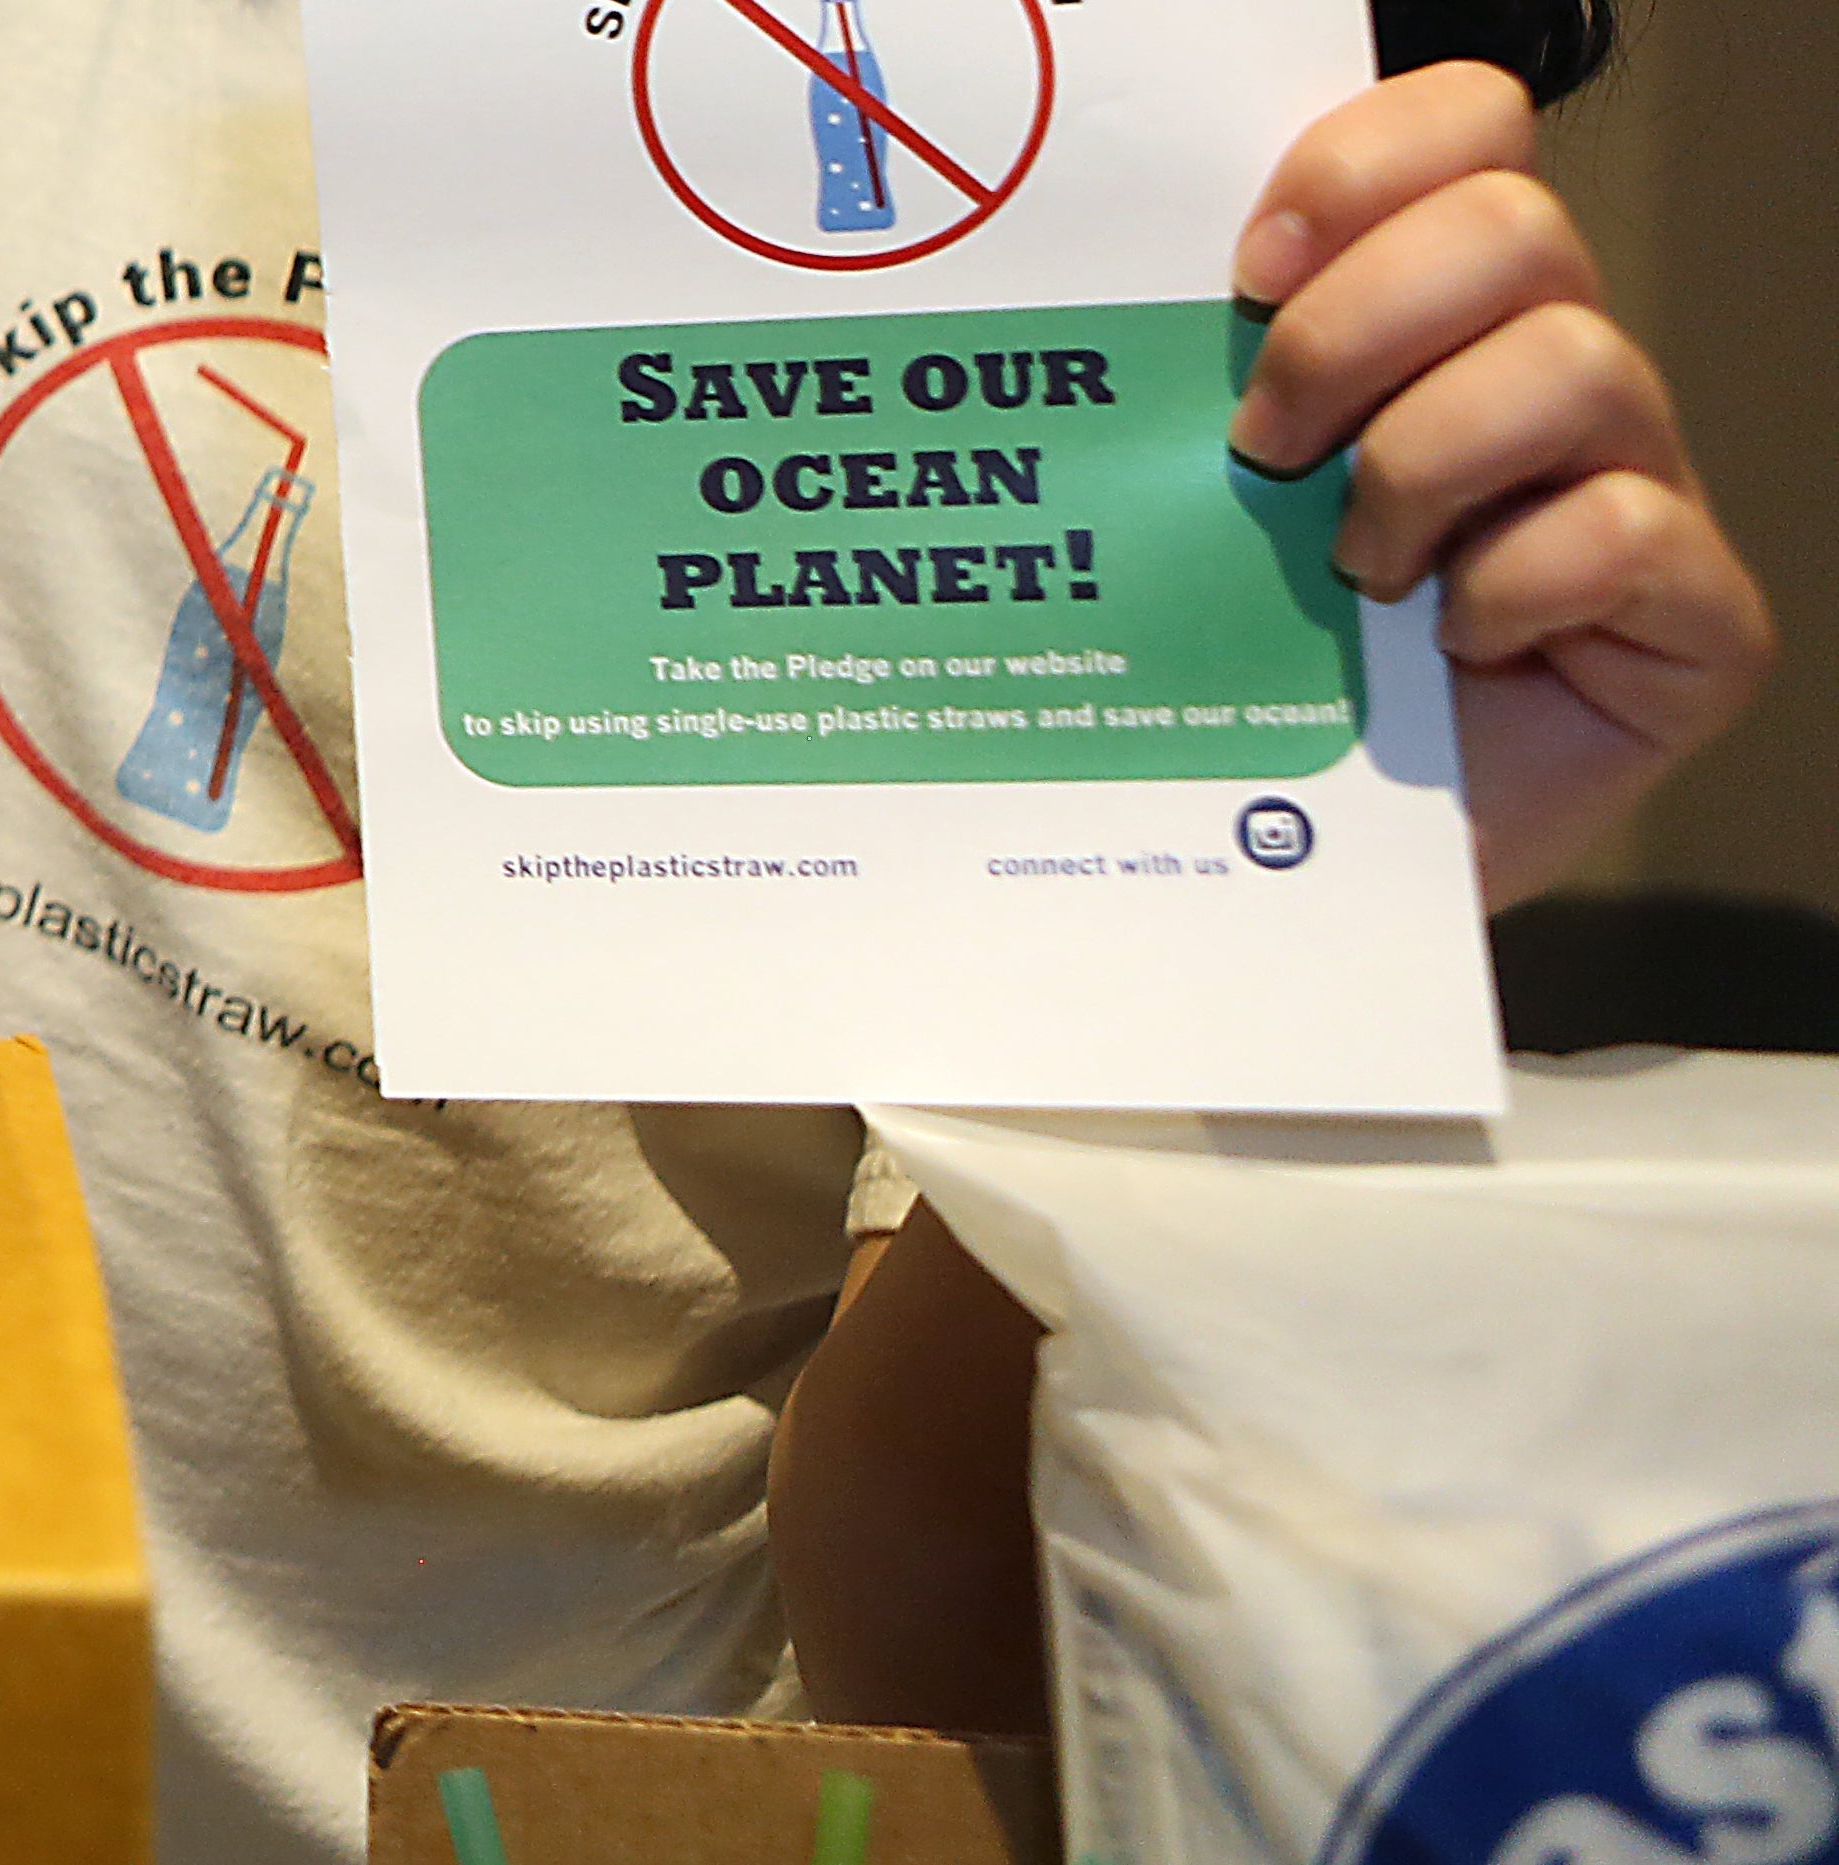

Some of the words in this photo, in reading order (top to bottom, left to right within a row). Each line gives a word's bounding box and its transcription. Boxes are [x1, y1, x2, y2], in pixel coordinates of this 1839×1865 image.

[123, 249, 251, 306] the
[619, 351, 873, 424] SAVE
[902, 349, 1116, 412] OUR
[699, 447, 1042, 514] OCEAN
[657, 529, 1101, 610] PLANET!
[650, 655, 722, 681] Take
[729, 655, 780, 680] the
[788, 653, 890, 685] Pledge
[898, 657, 935, 679] on
[944, 657, 995, 678] our
[1004, 649, 1126, 676] website
[463, 714, 492, 737] to
[500, 711, 561, 744] skip
[570, 712, 649, 744] using
[656, 706, 809, 738] single-use
[817, 704, 919, 738] plastic
[927, 705, 1026, 732] straws
[1036, 702, 1095, 730] and
[1103, 704, 1175, 728] save
[1182, 703, 1235, 726] our
[1244, 698, 1350, 726] ocean!
[502, 852, 859, 882] skiptheplasticstraw.com
[987, 853, 1107, 876] connect
[1116, 852, 1183, 876] with
[1196, 855, 1230, 876] us
